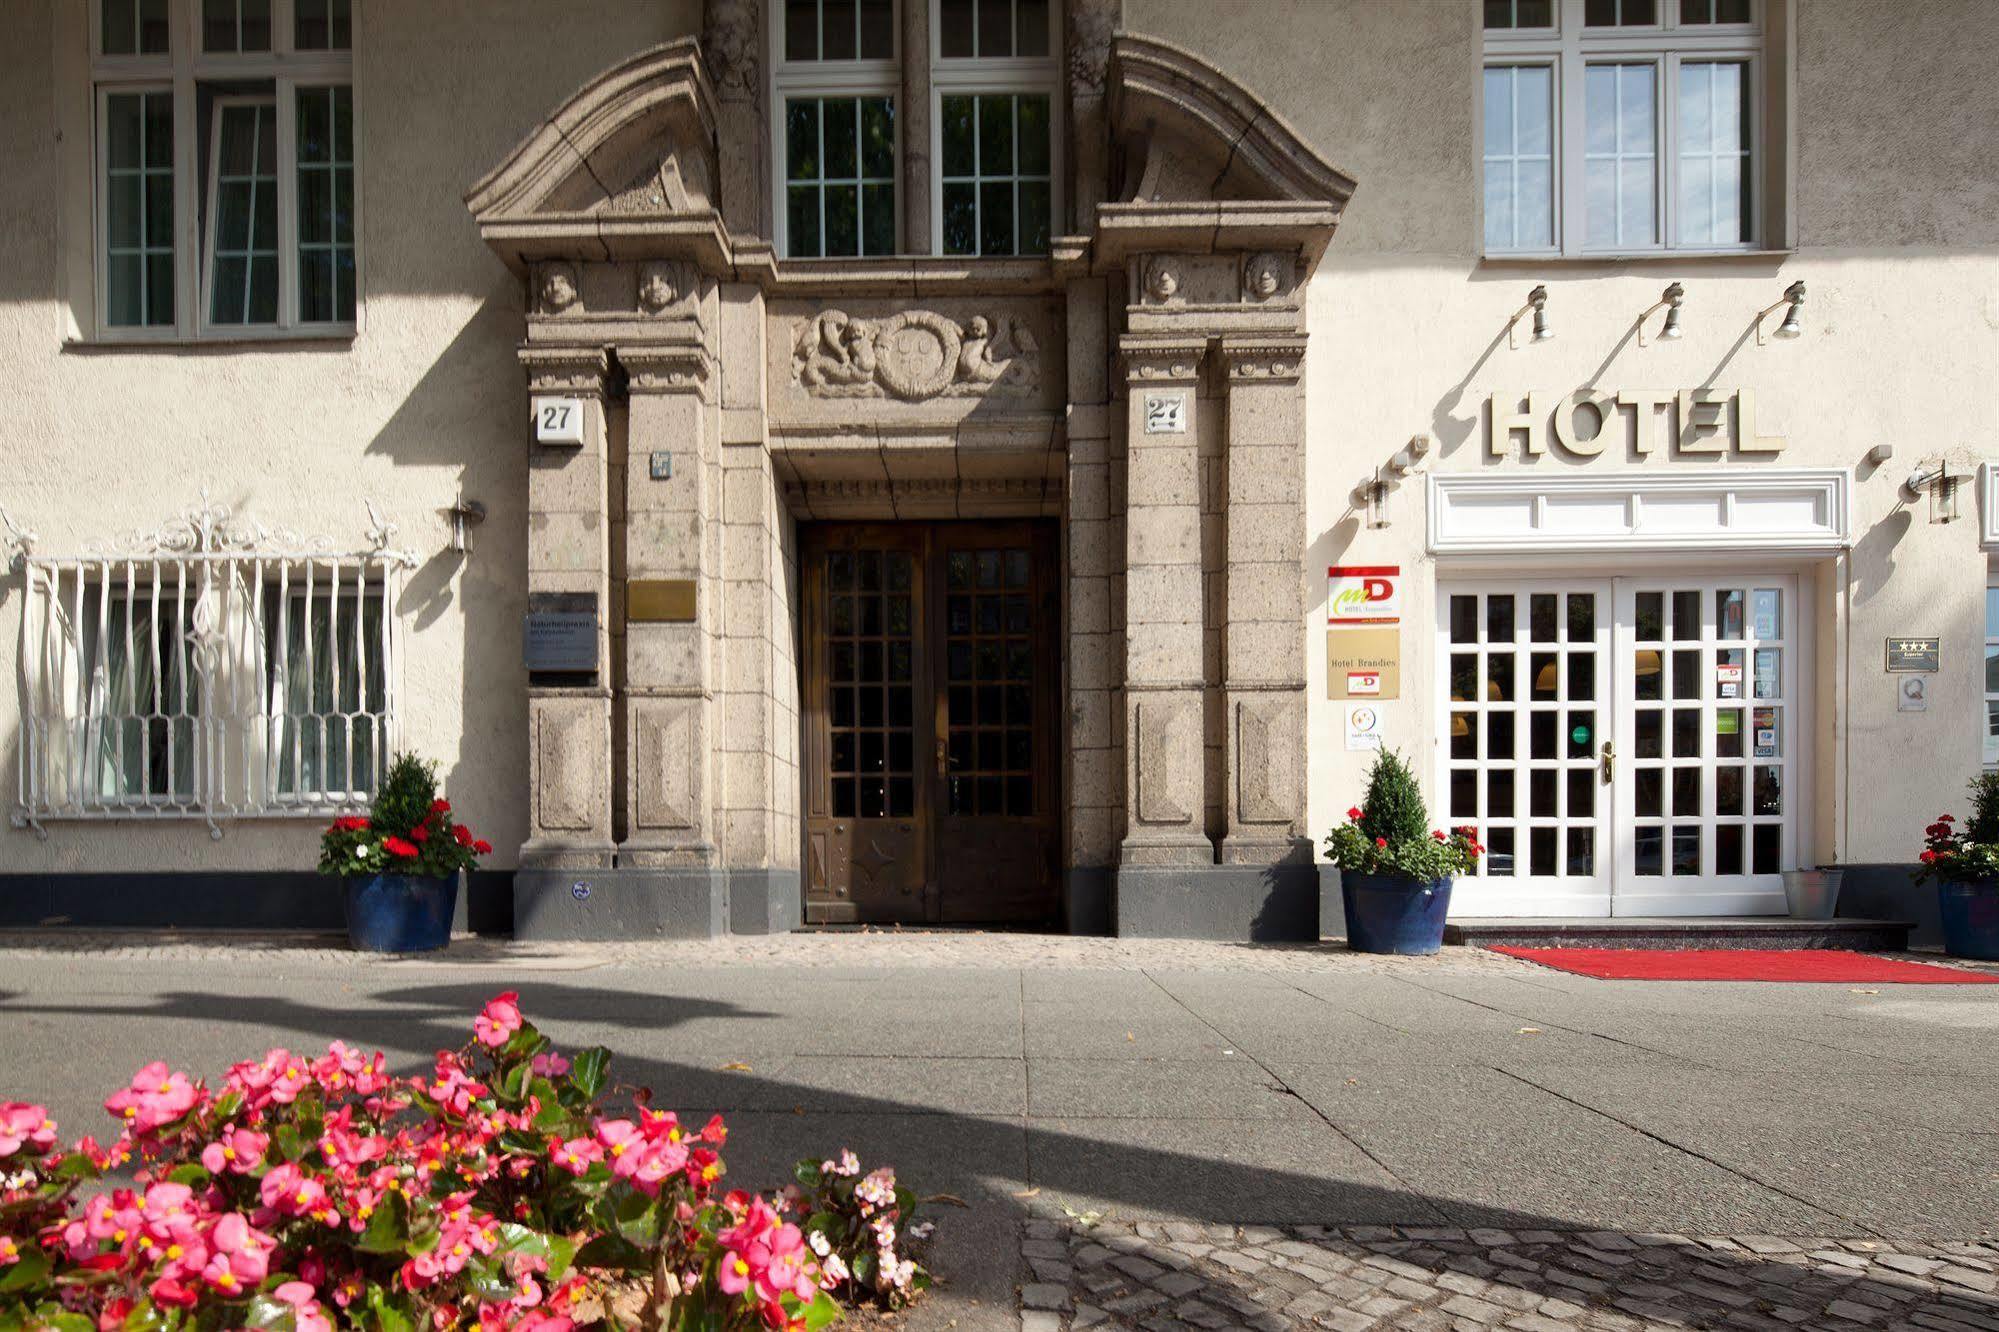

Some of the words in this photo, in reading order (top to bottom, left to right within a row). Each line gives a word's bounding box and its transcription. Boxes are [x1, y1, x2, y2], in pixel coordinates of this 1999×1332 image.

[543, 406, 571, 430] 27
[1148, 399, 1181, 420] 27
[1490, 387, 1787, 456] HOTEL
[1331, 658, 1354, 668] Hotel
